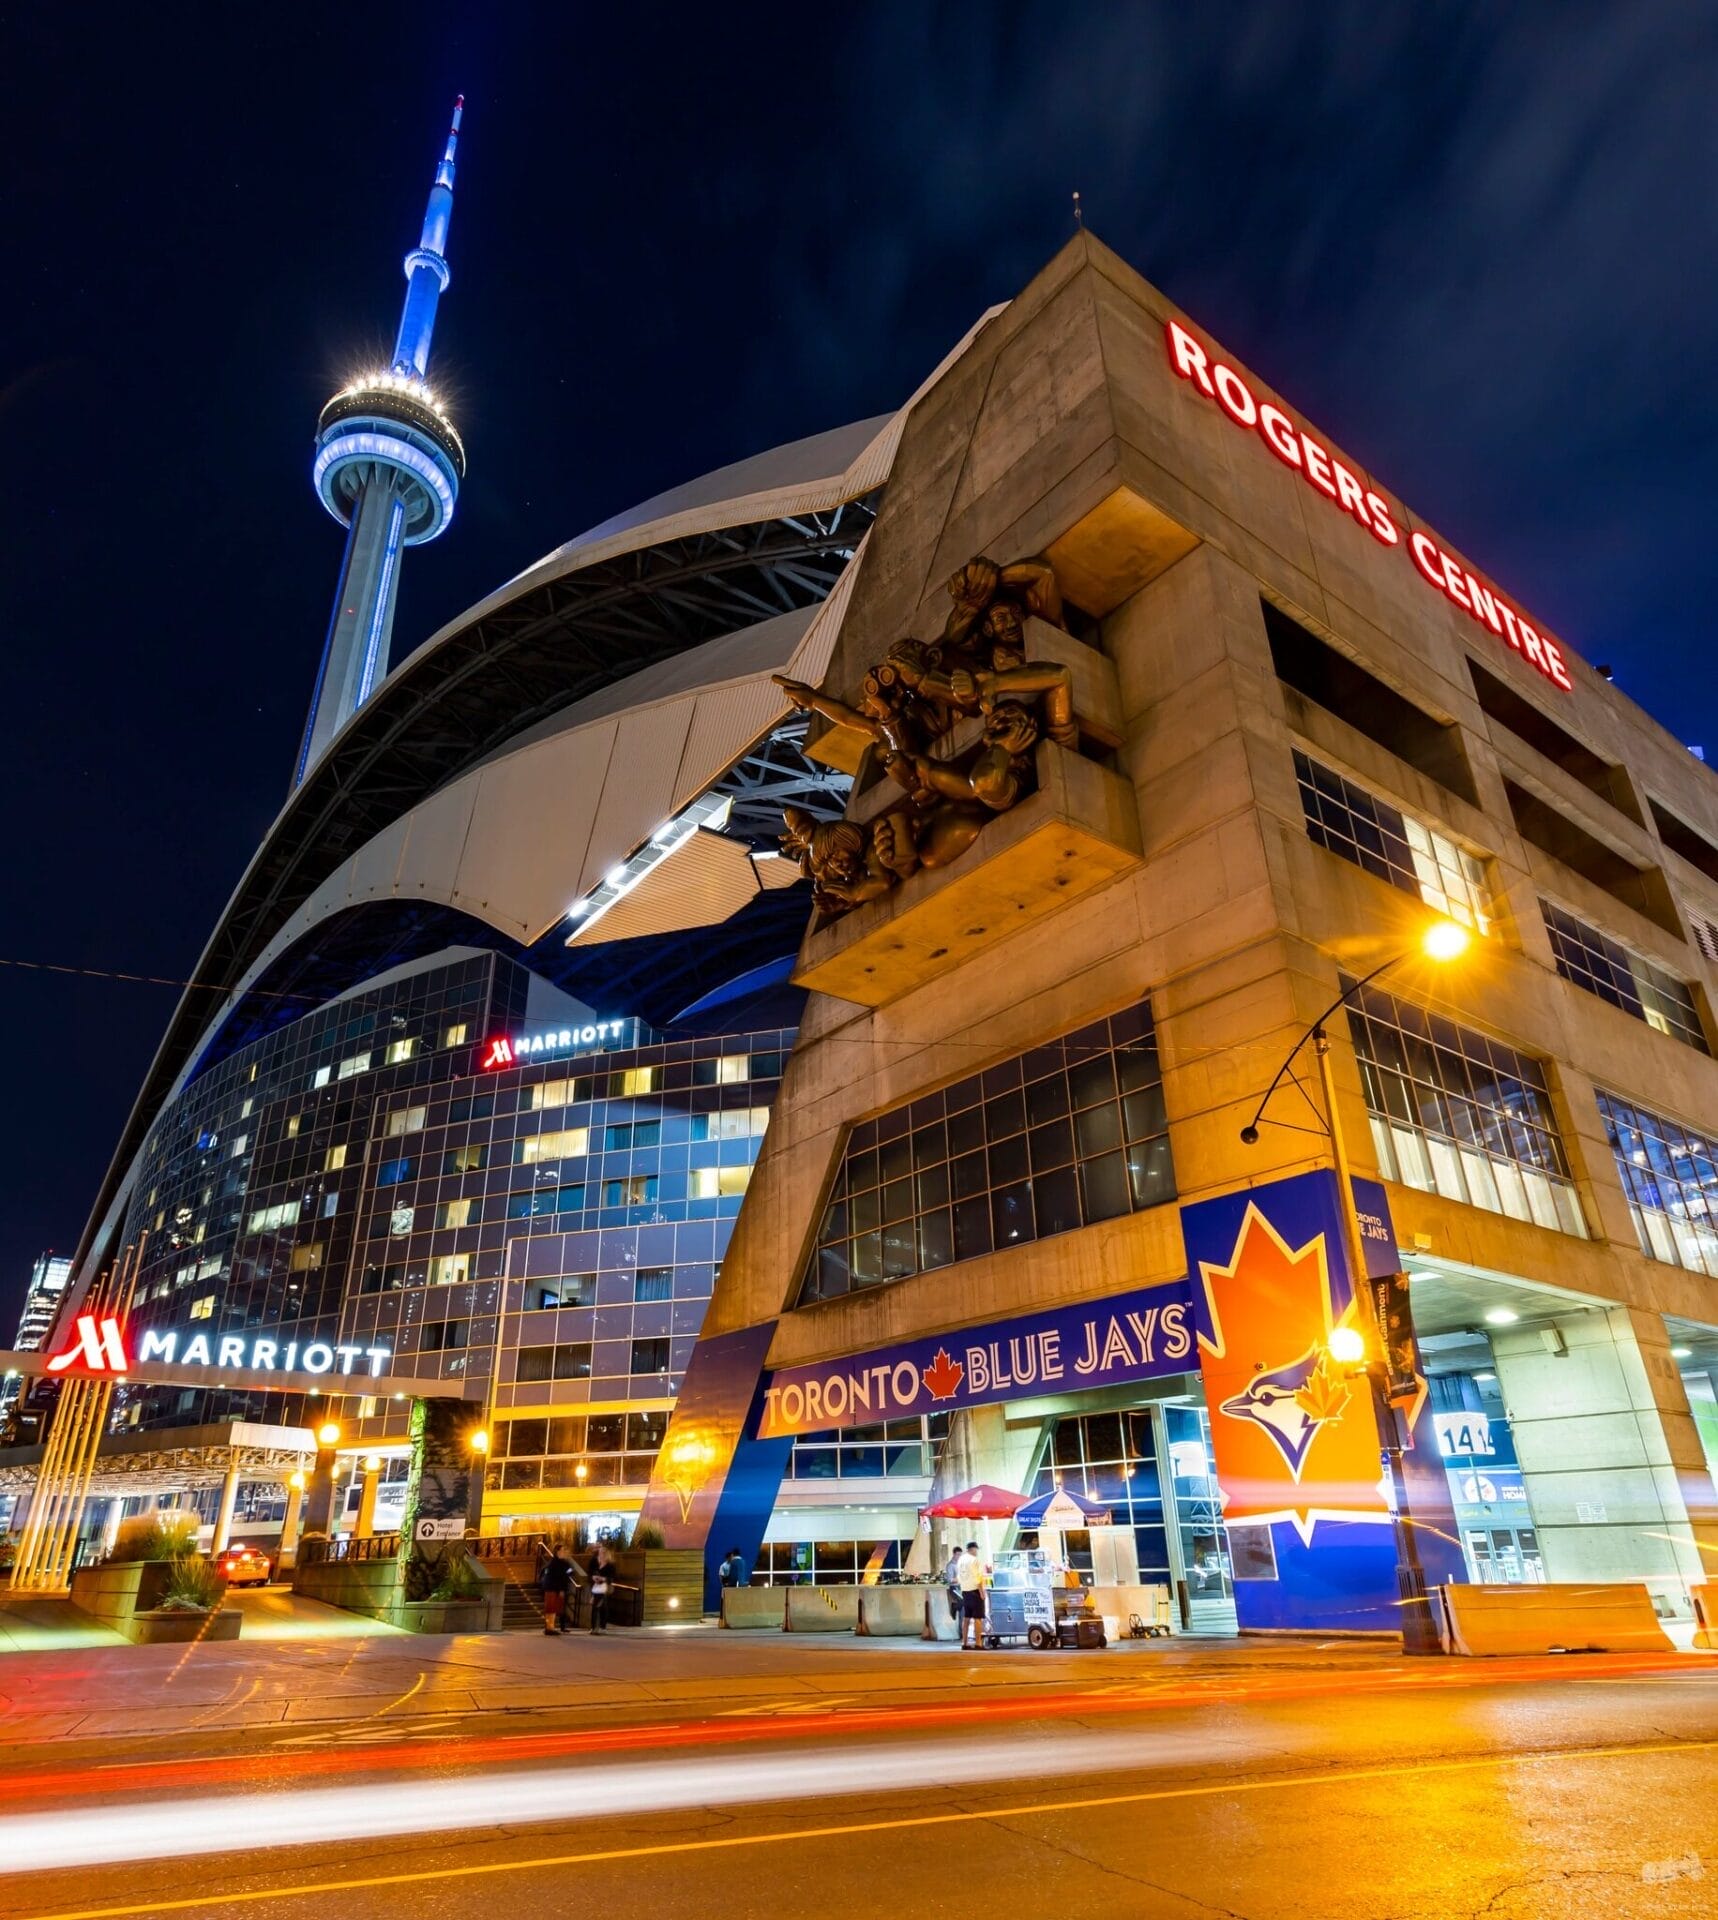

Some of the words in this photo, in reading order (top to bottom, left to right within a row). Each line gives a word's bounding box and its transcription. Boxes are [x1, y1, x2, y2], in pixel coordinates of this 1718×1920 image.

[1165, 319, 1399, 547] ROGERS
[1408, 530, 1573, 692] CENTRE
[514, 1020, 625, 1056] MARRIOTT
[1356, 1212, 1382, 1227] ORONTO
[1367, 1224, 1389, 1242] JAYS
[138, 1330, 392, 1378] MARRIOTT
[763, 1359, 920, 1429] TORONTO
[965, 1329, 1065, 1395] BLUE
[1073, 1303, 1192, 1376] JAYS
[1443, 1424, 1474, 1454] 14
